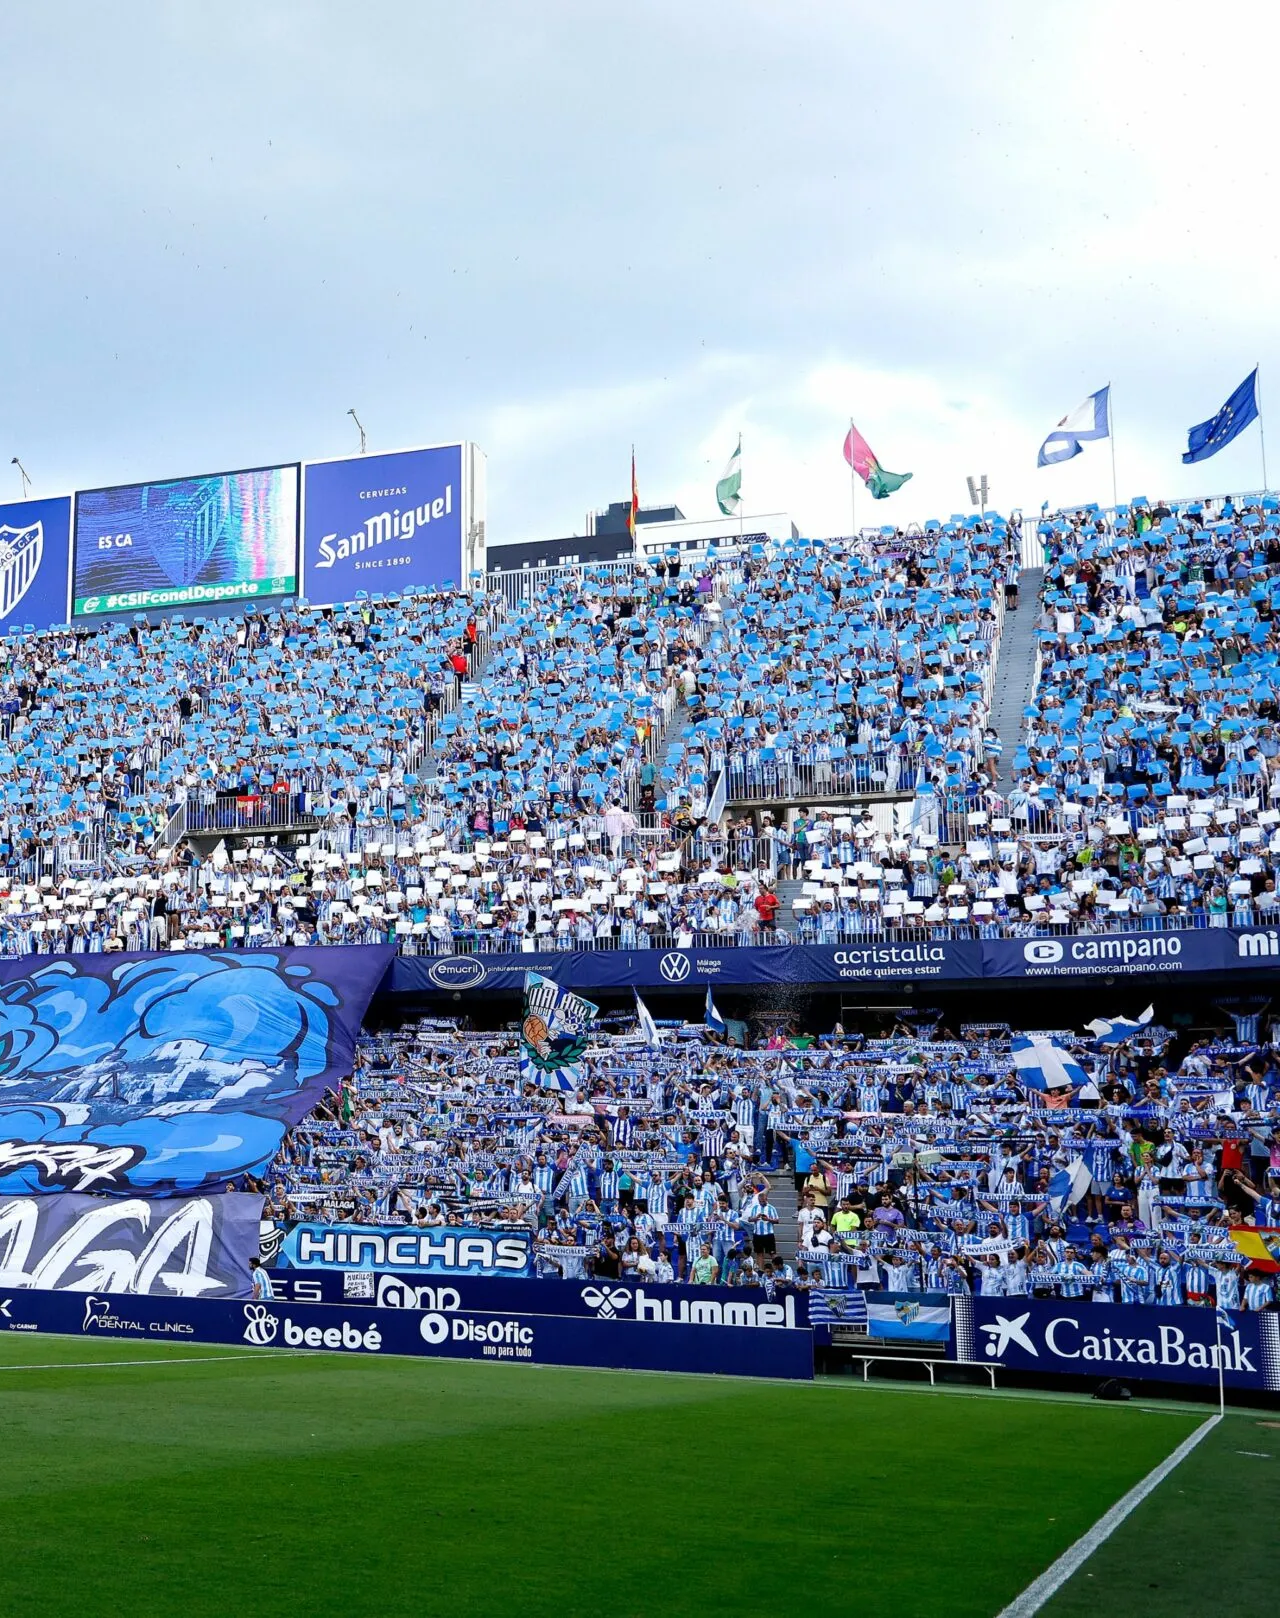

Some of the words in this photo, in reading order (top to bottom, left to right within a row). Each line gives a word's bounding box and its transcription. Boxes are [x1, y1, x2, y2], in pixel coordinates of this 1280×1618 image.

[359, 487, 407, 499] CERVEZAS
[98, 536, 112, 549] ES
[115, 534, 132, 547] CA
[354, 559, 384, 570] SINCE
[386, 556, 412, 567] 1890
[106, 582, 258, 608] #CSIFconelDeporte
[833, 944, 945, 964] acristalia
[1072, 936, 1182, 961] campano
[438, 964, 478, 974] emucril
[696, 966, 720, 974] Wagen
[839, 966, 871, 977] donde
[874, 966, 912, 978] quieres
[914, 965, 941, 975] estar
[1024, 960, 1183, 976] www.hermanoscampano.com
[932, 1126, 950, 1134] SUR
[801, 1139, 829, 1148] FONDO
[840, 1139, 859, 1147] SUR
[577, 1151, 603, 1159] FONDO
[1025, 1193, 1045, 1201] SUR
[1162, 1196, 1206, 1205] MALAGA
[323, 1199, 355, 1209] MALAGA
[934, 1207, 963, 1217] FONDO
[974, 1211, 994, 1221] SUR
[663, 1223, 691, 1231] FONDO
[702, 1223, 721, 1231] SUR
[1202, 1226, 1224, 1235] SUR
[966, 1243, 1012, 1254] INVENCIBLES
[1131, 1239, 1150, 1247] NDO
[301, 1231, 528, 1268] HINCHAS
[545, 1246, 585, 1255] INVENCIBLES
[894, 1250, 915, 1259] SUR
[798, 1252, 829, 1261] FONDO
[840, 1254, 862, 1264] SUR
[1223, 1252, 1244, 1262] SUR
[1031, 1274, 1062, 1283] FONDO
[1074, 1275, 1095, 1283] SUR
[636, 1288, 795, 1328] hummel
[98, 1319, 145, 1331] DENTAL
[284, 1318, 382, 1350] beebé
[452, 1319, 534, 1344] DisOfic
[1045, 1316, 1257, 1373] CaixaBank
[483, 1345, 497, 1356] uno
[498, 1346, 514, 1358] para
[516, 1345, 532, 1357] todo
